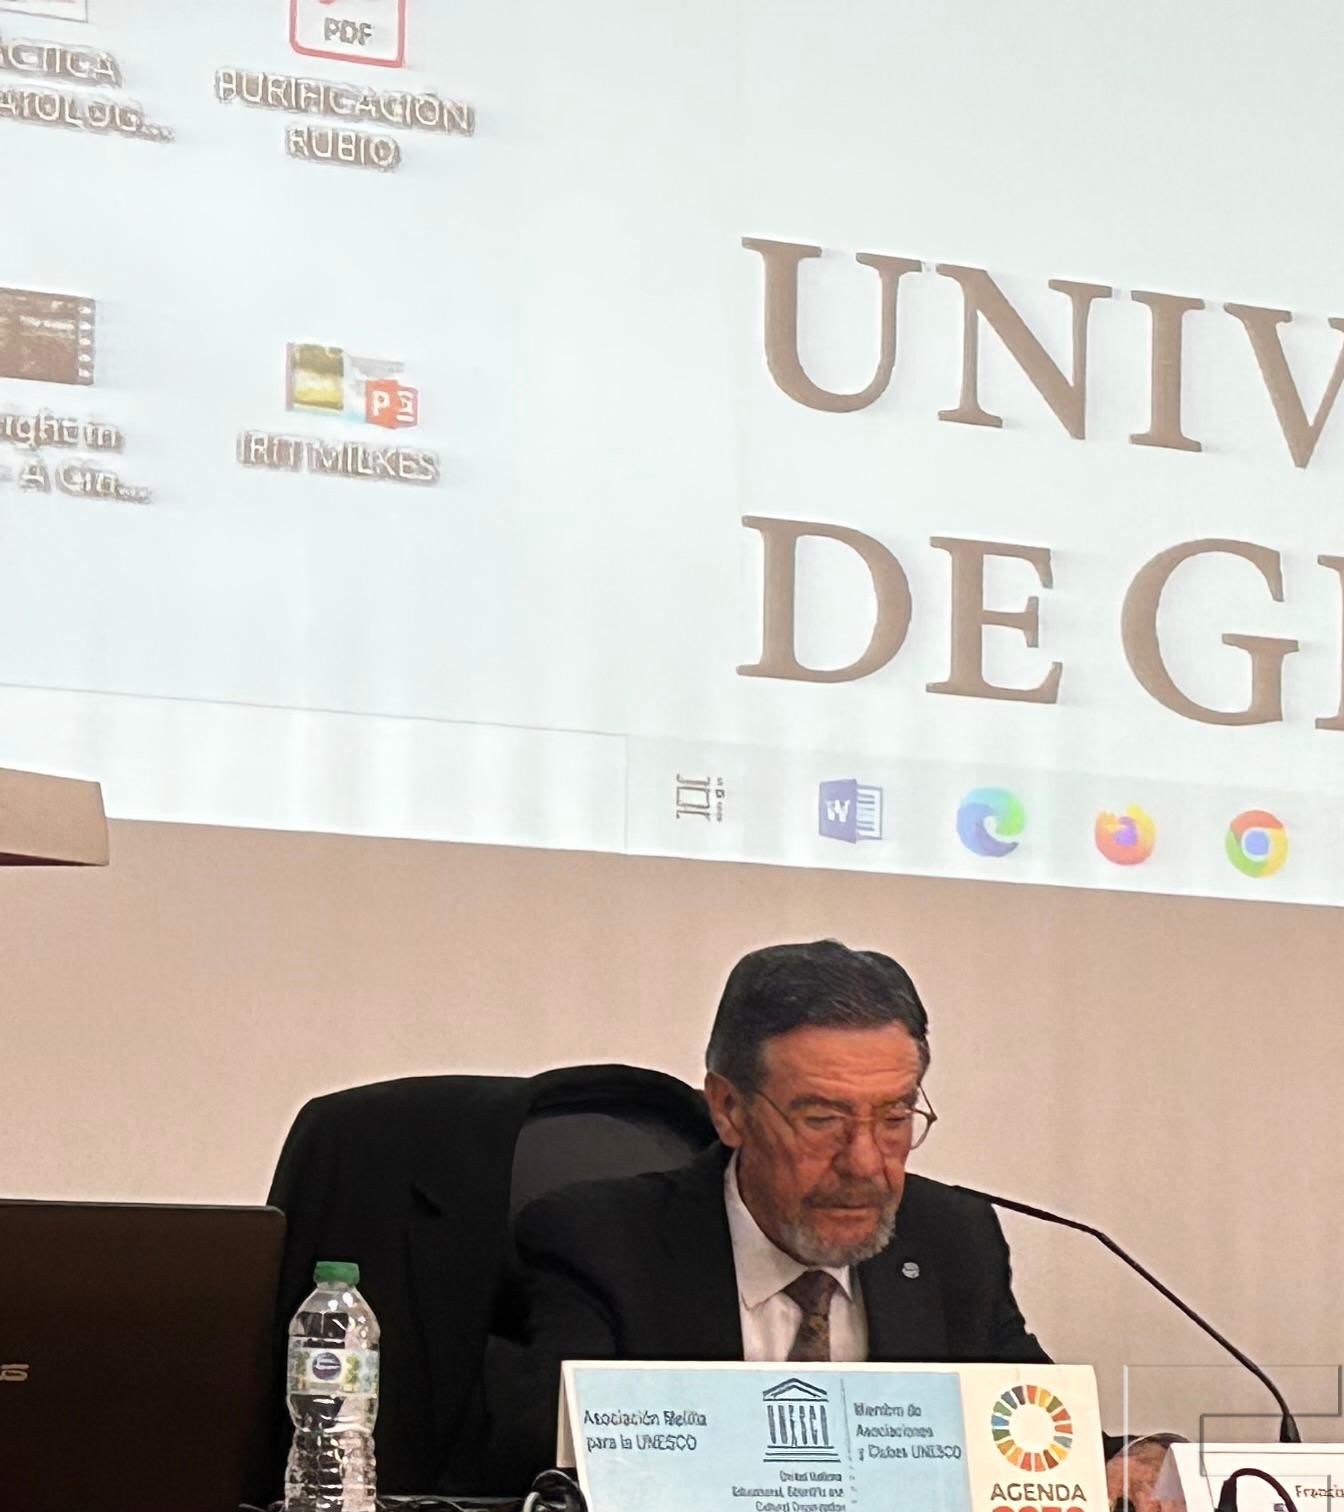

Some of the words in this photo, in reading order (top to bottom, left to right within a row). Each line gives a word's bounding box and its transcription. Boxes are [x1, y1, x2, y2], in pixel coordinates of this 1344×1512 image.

[323, 17, 373, 46] PDF
[217, 68, 470, 132] PURIFICACIÓN
[288, 128, 396, 168] RUBIO
[736, 514, 1064, 709] DE
[584, 1410, 660, 1426] Asociación
[587, 1436, 617, 1452] para
[636, 1434, 698, 1450] UNESCO
[911, 1445, 962, 1460] UNESCO
[990, 1483, 1087, 1503] AGENDA
